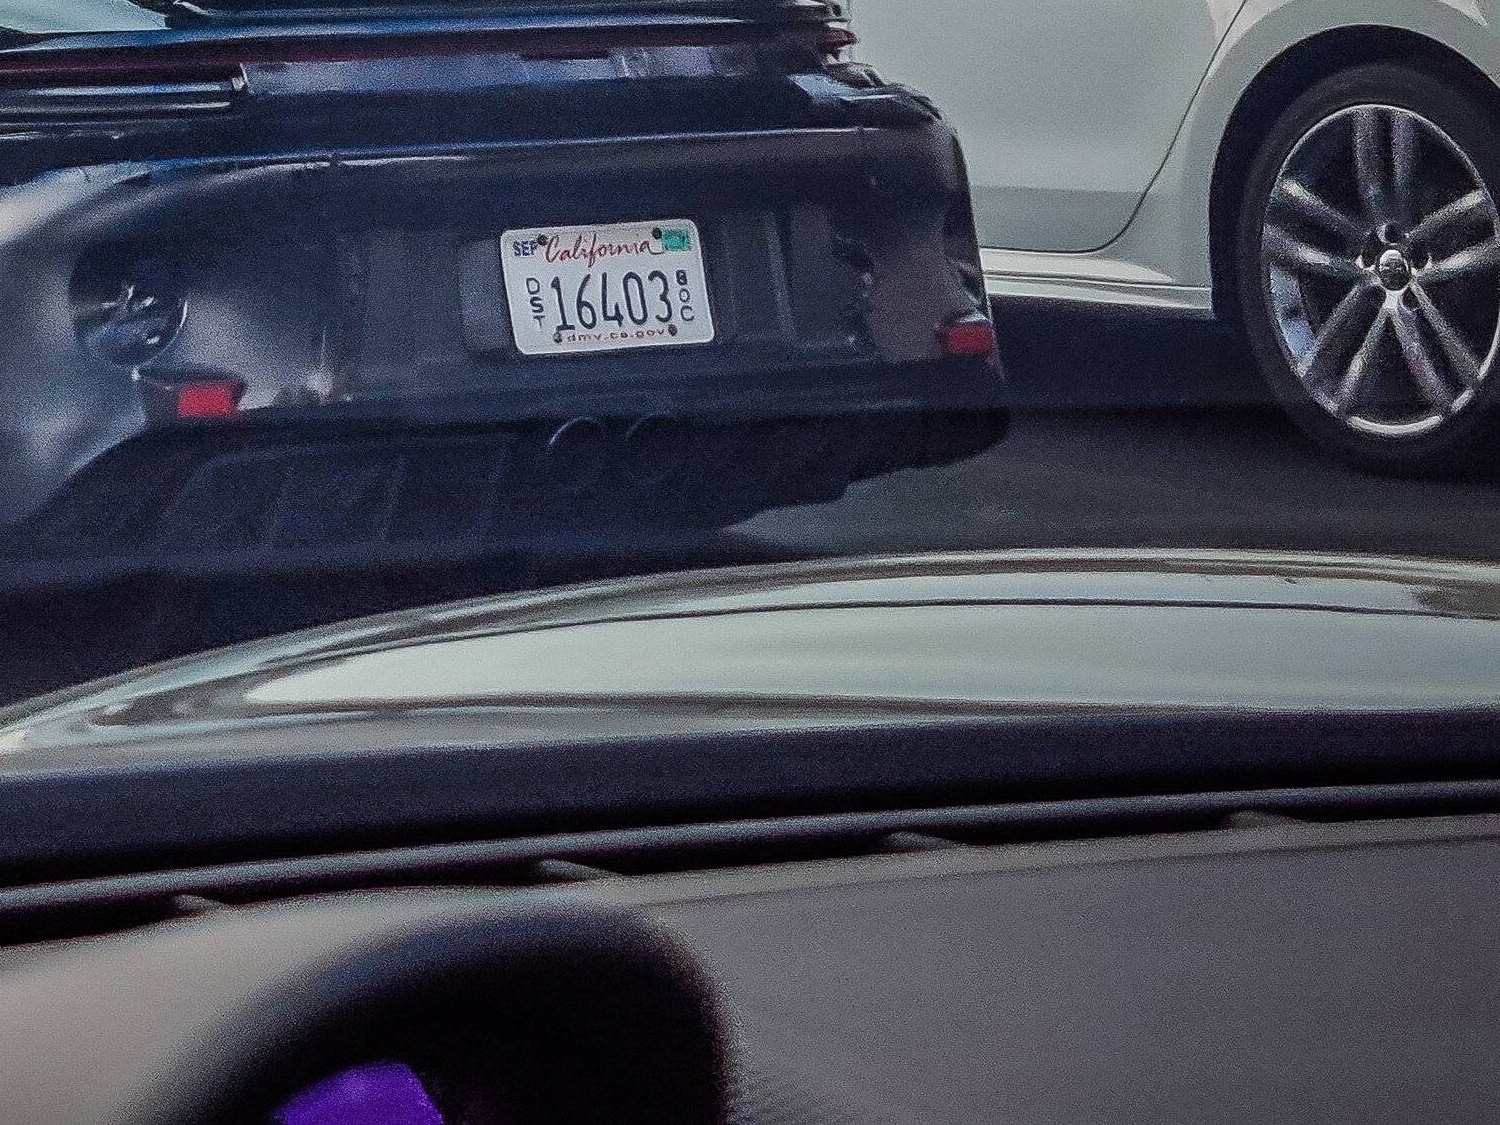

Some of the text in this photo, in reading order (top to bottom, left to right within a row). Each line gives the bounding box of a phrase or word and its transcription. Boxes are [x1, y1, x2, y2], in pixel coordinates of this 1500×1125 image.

[512, 240, 539, 257] SEP
[544, 233, 665, 268] California
[550, 270, 673, 331] 16403
